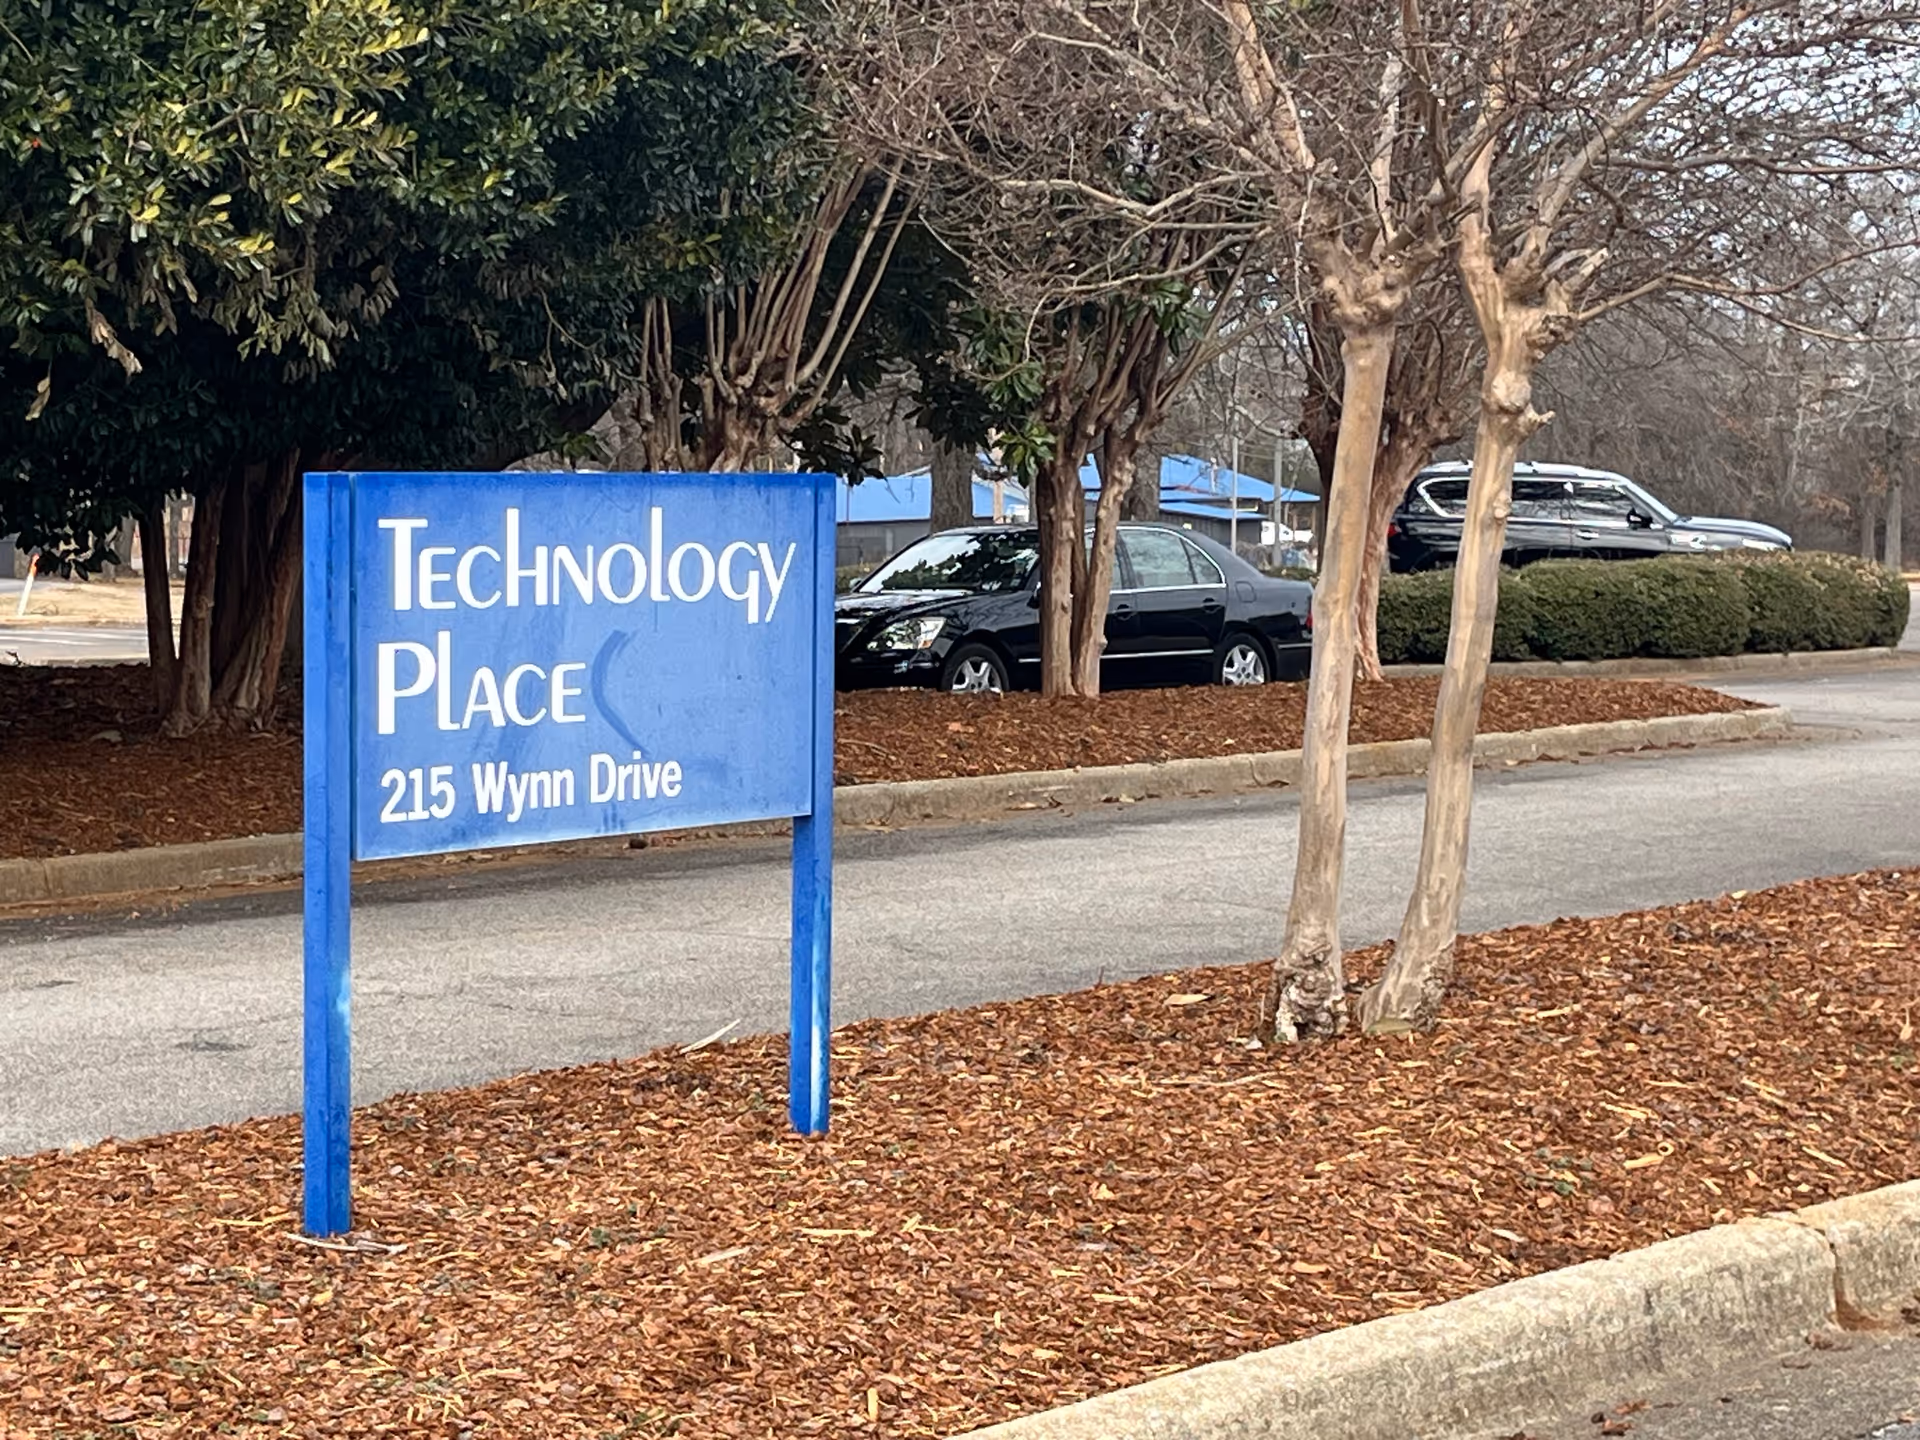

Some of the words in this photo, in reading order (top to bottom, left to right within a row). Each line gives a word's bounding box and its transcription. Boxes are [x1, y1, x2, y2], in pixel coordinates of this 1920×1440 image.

[380, 765, 456, 824] 215
[471, 760, 575, 823] Wynn
[589, 750, 683, 804] Drive
